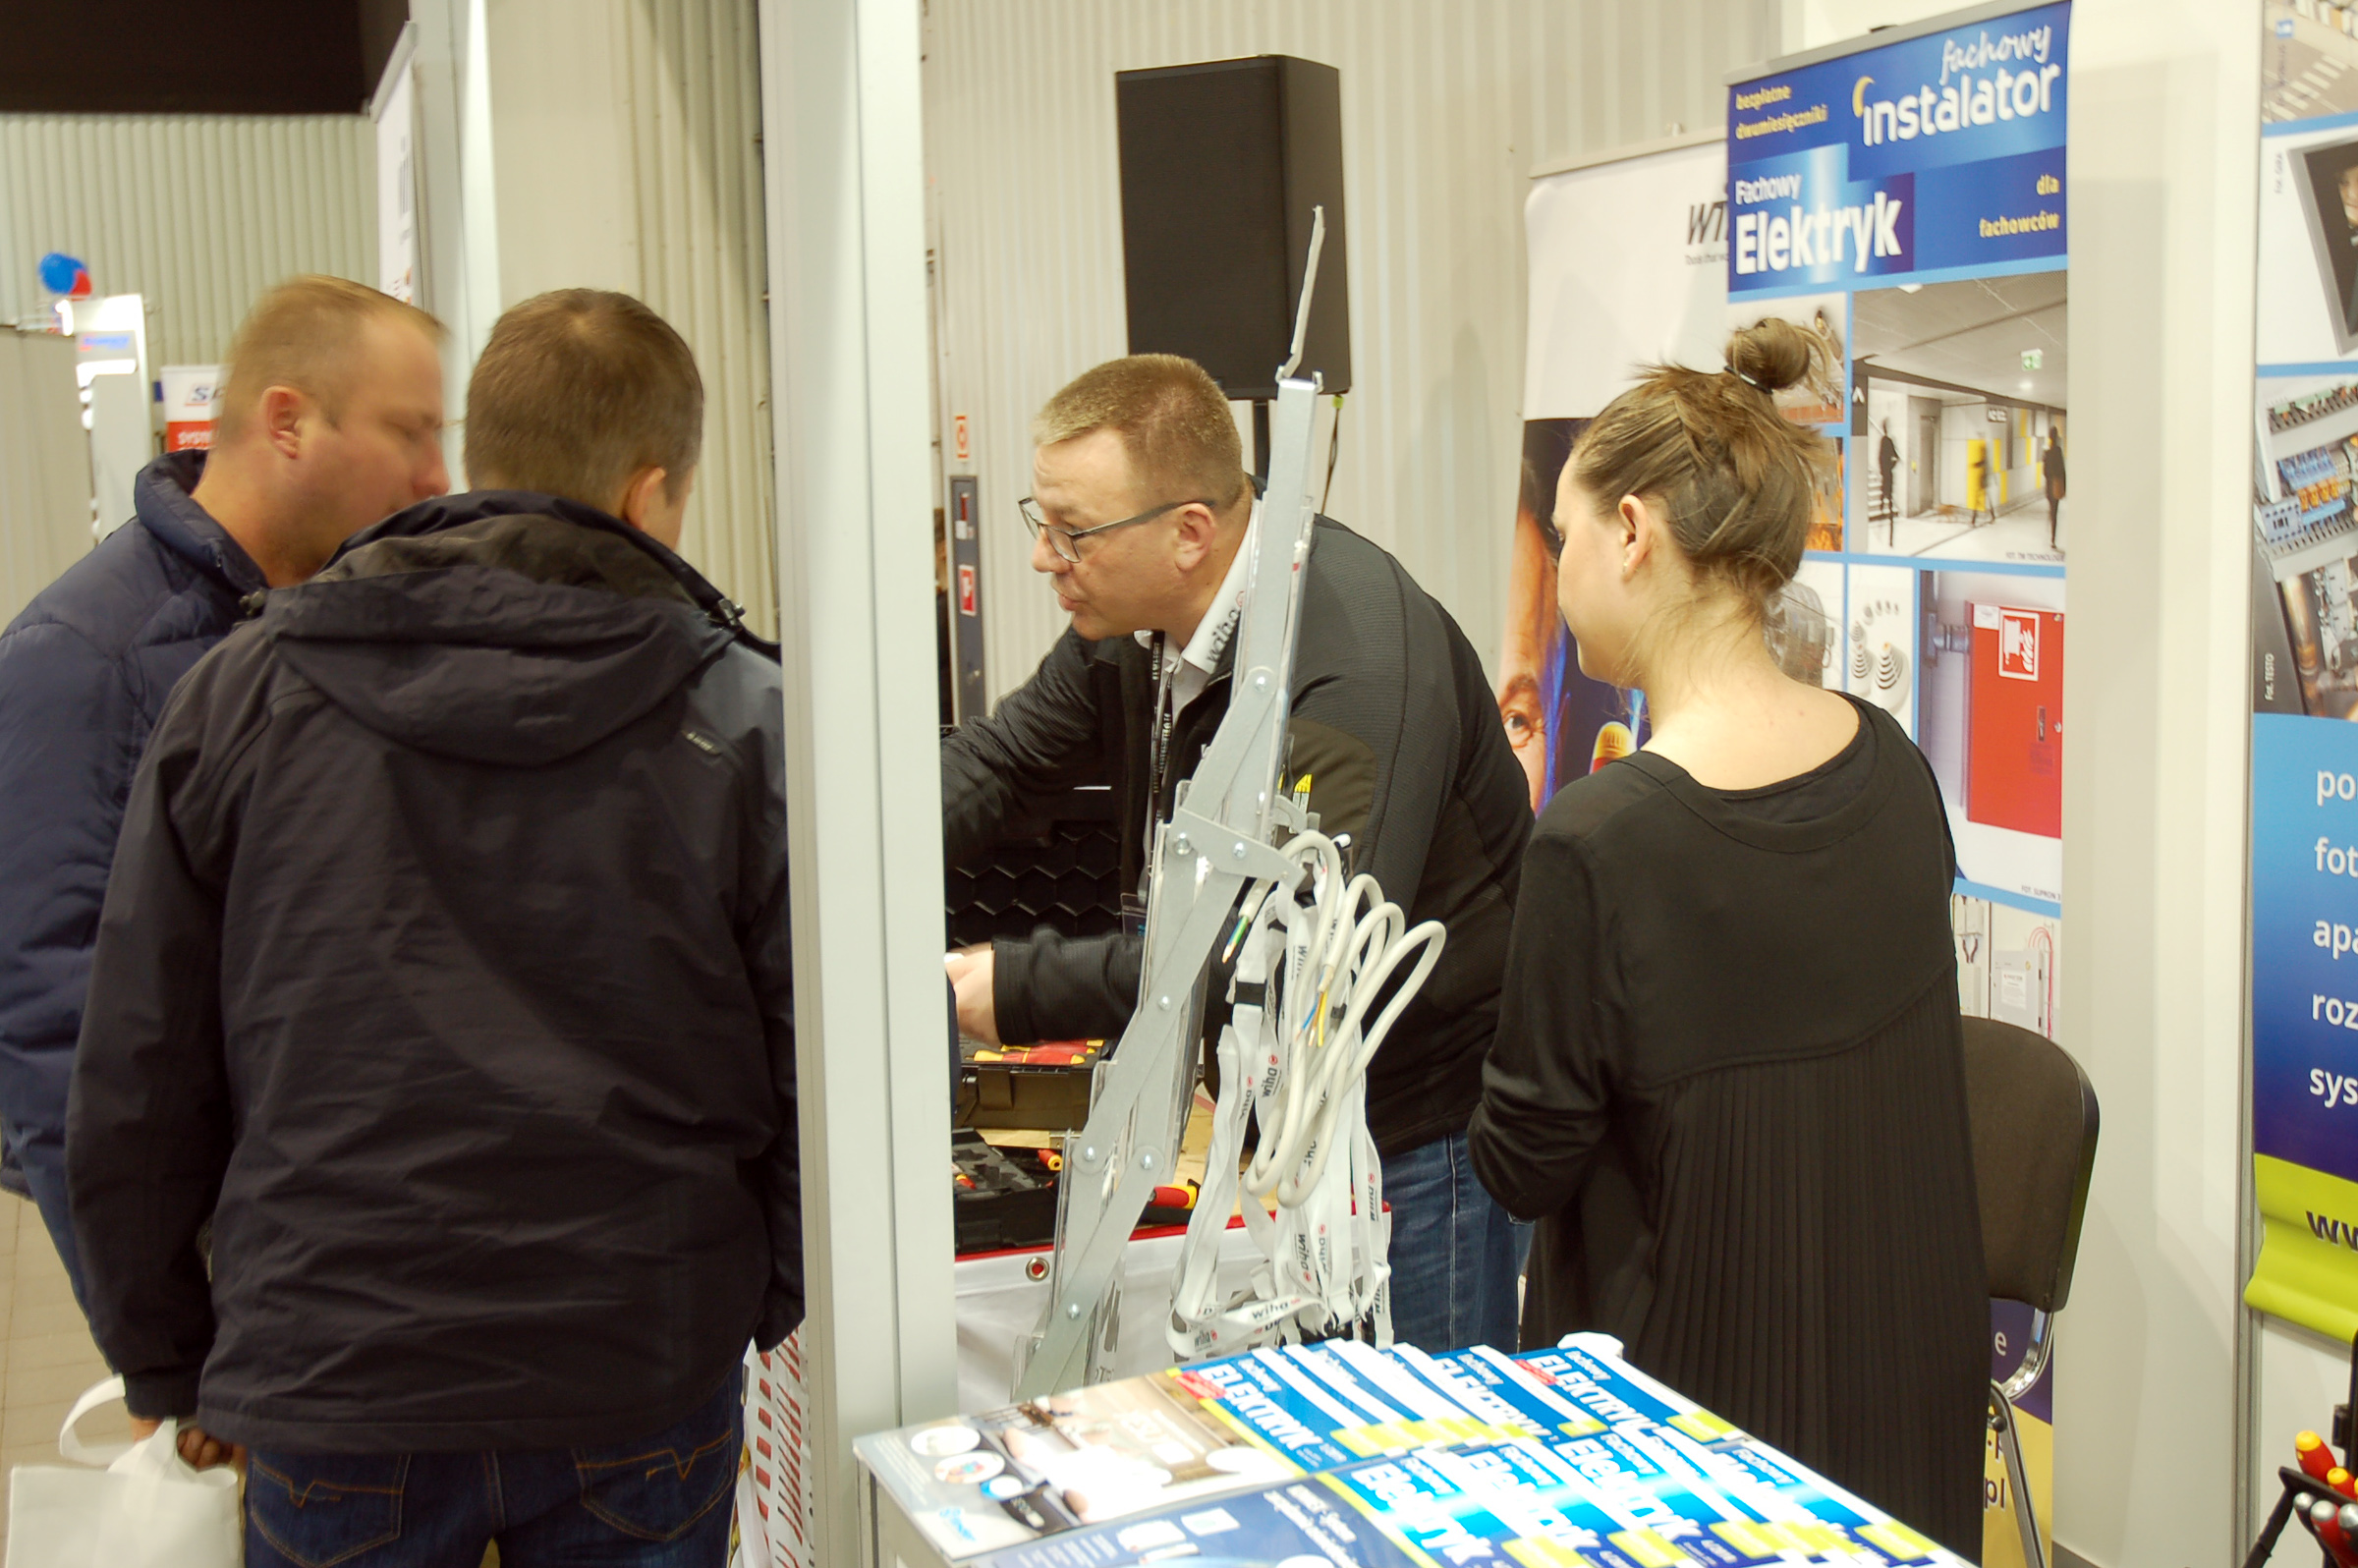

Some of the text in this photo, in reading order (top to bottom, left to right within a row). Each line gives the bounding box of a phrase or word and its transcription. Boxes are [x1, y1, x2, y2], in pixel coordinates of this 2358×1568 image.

[1939, 25, 2051, 85] fachowy
[1853, 63, 2061, 146] instalator
[1736, 174, 1802, 204] Fachowy
[2037, 174, 2060, 196] dla
[1736, 191, 1902, 274] Elektryk
[1980, 210, 2060, 239] fachowców
[2265, 652, 2274, 681] TESTO
[2317, 769, 2358, 807] po
[1262, 1067, 1278, 1098] wiha
[1298, 1233, 1311, 1271] wiha
[1252, 1301, 1289, 1321] wiha
[1198, 1363, 1323, 1451] ELEKTRYK
